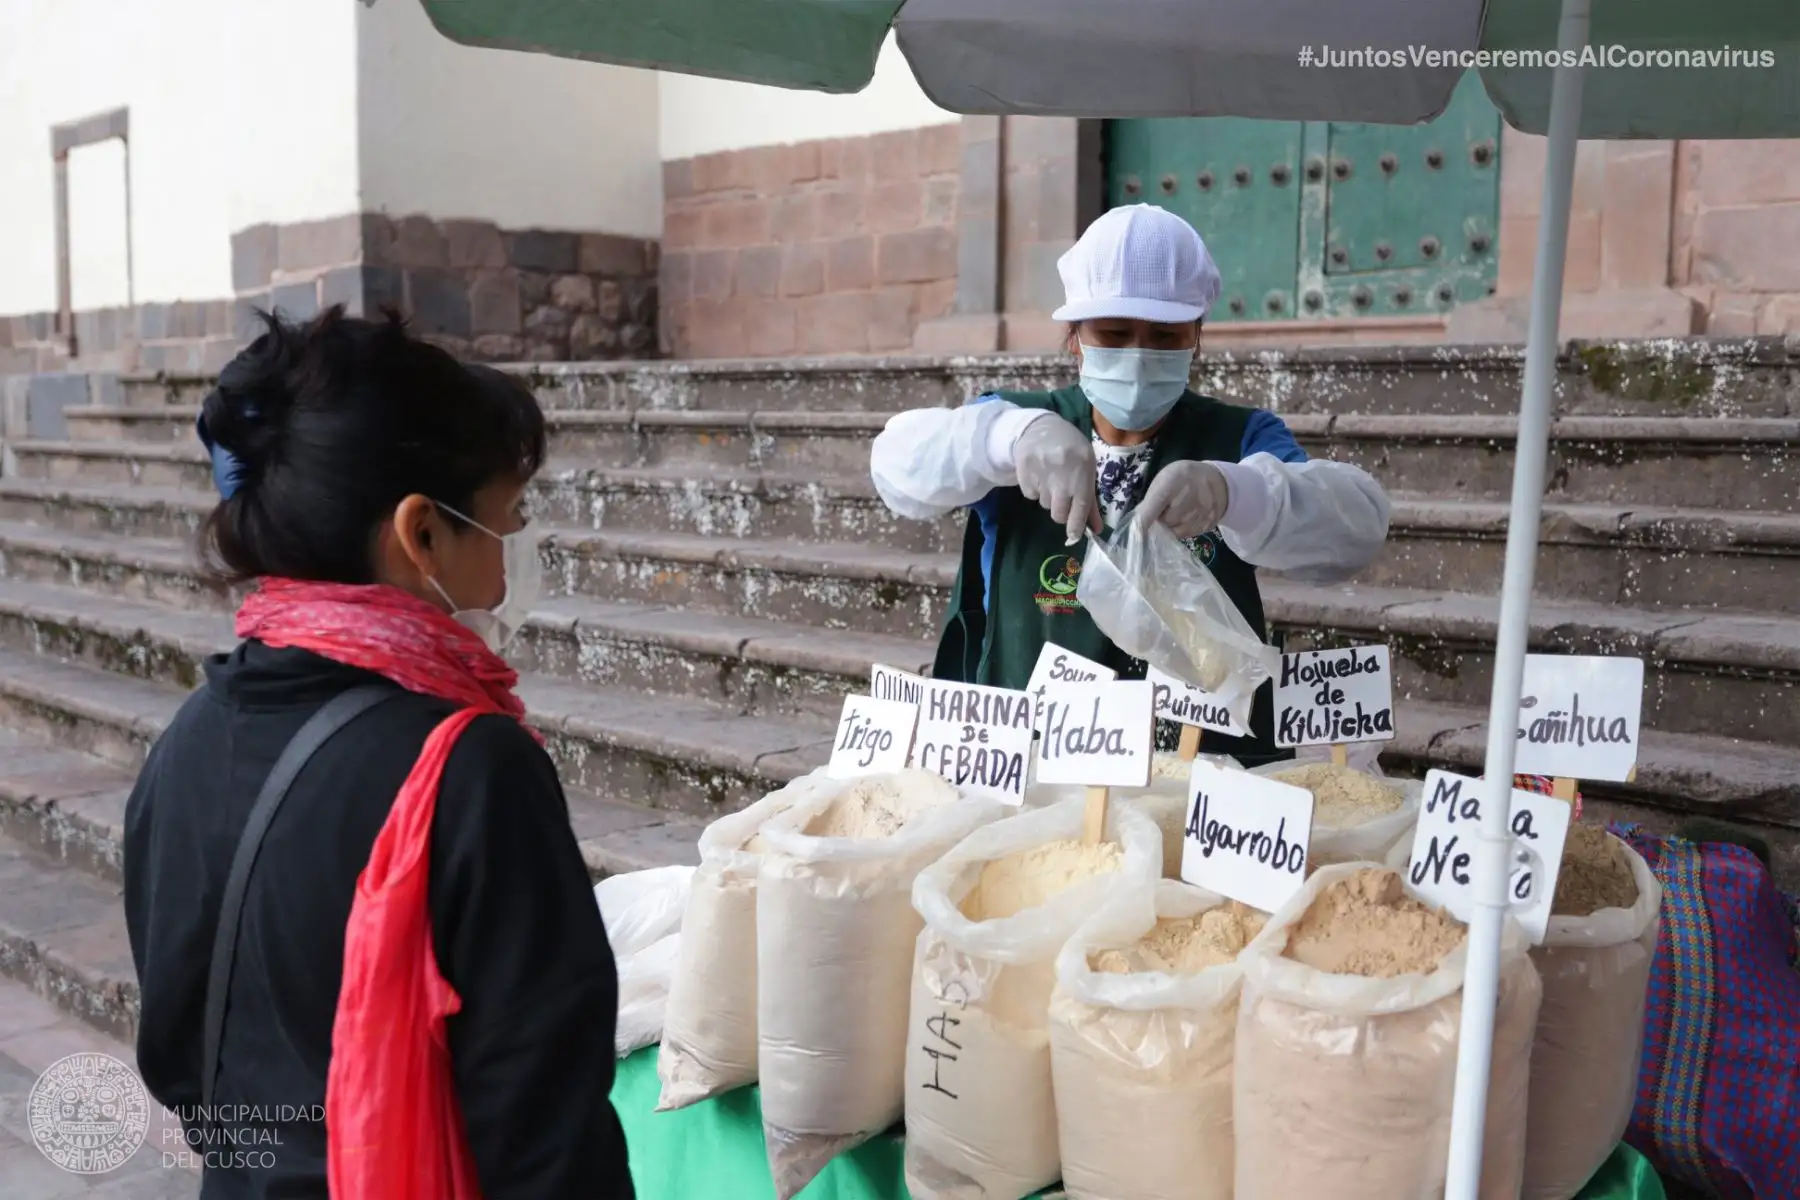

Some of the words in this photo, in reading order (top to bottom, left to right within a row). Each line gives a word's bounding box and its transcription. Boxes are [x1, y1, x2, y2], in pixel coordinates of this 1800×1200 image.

[929, 687, 1029, 729] HARINA
[1153, 684, 1230, 727] Quinua
[1315, 681, 1346, 706] de
[960, 725, 989, 744] DE
[921, 742, 1023, 794] CEBADA
[1427, 777, 1539, 840] Maa
[1185, 791, 1304, 874] Algarrobo
